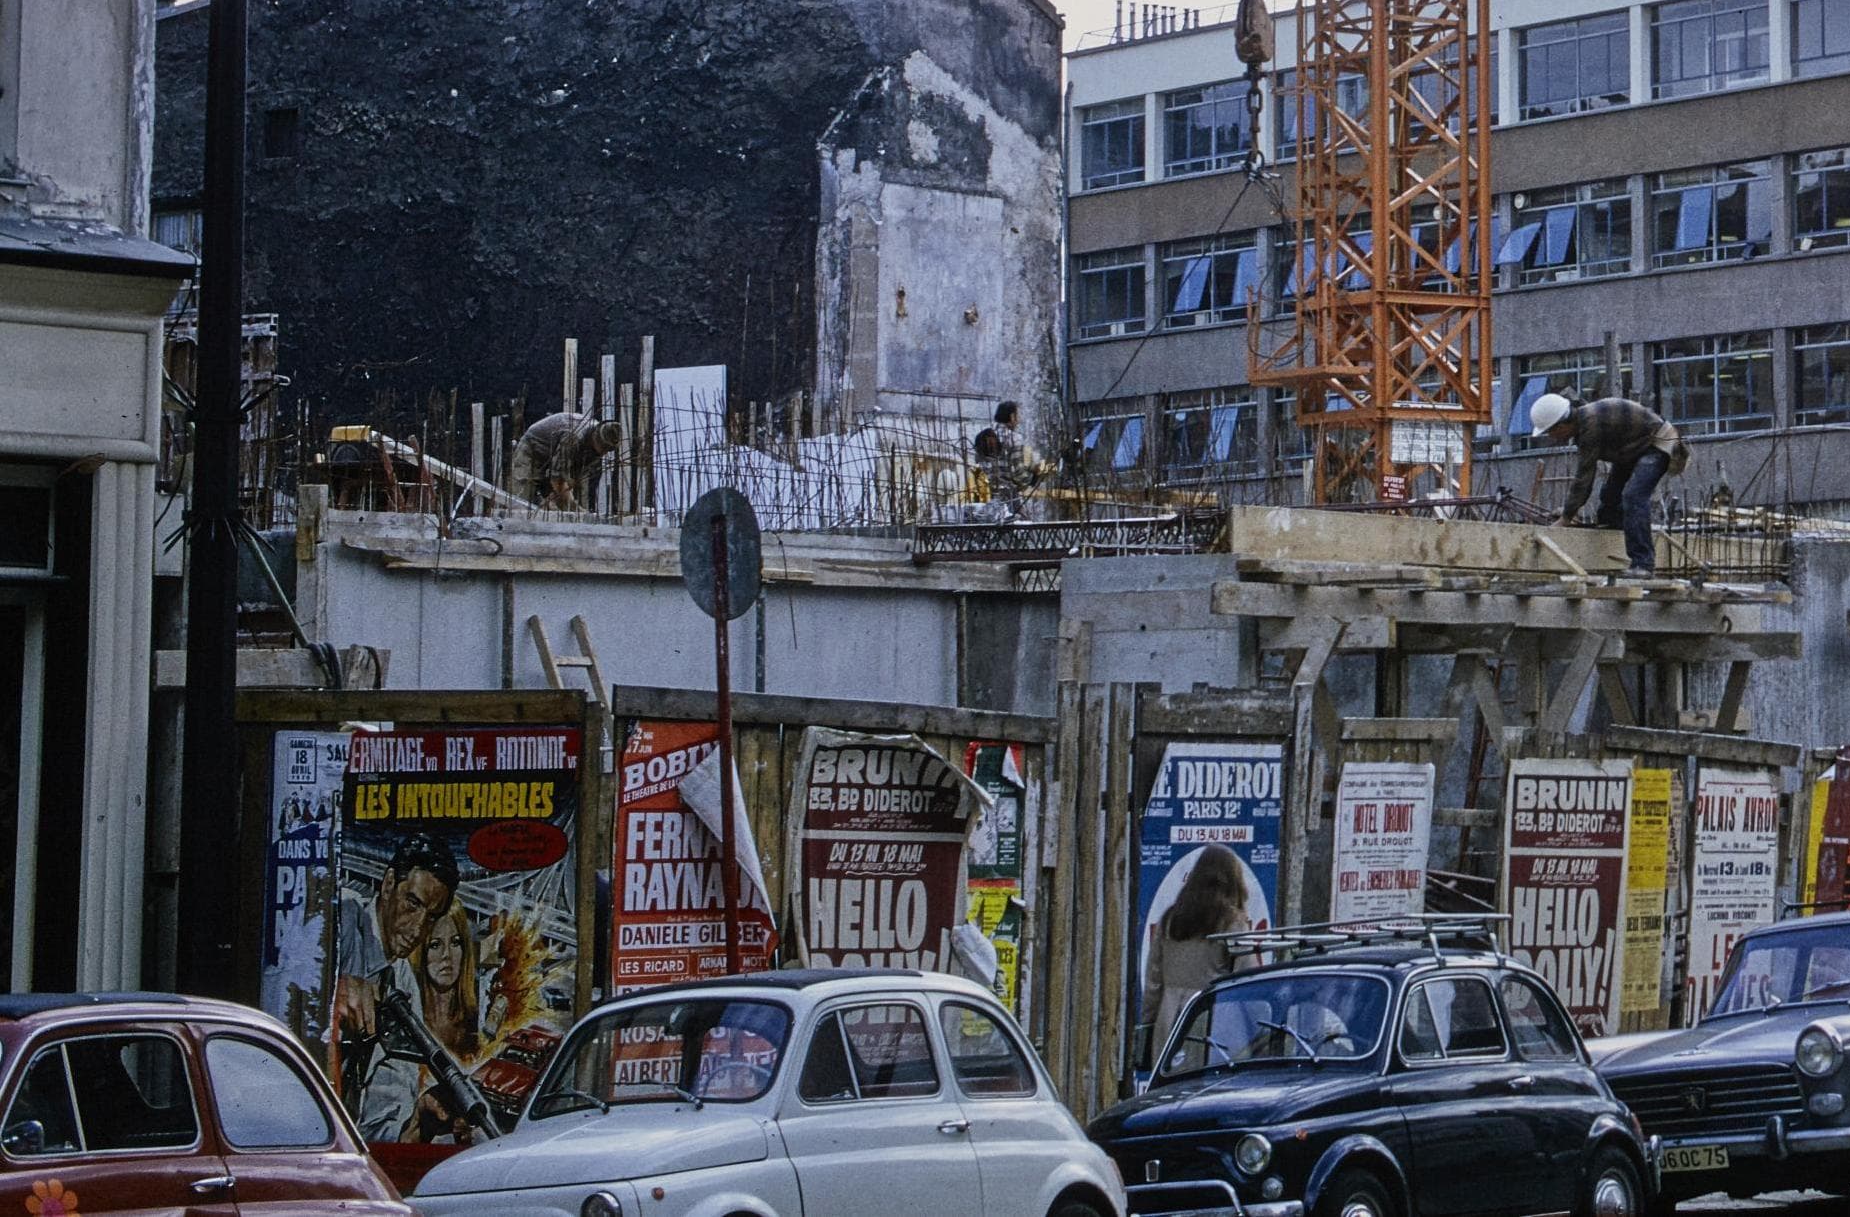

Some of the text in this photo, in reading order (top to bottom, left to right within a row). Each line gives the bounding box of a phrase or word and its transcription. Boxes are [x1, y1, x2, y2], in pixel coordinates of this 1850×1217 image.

[296, 750, 307, 764] 18
[350, 737, 424, 773] ERMITAGE
[446, 737, 475, 772] REX
[496, 735, 567, 771] ROTONDE
[633, 741, 639, 753] 7
[1177, 761, 1281, 799] DIDEROT
[355, 781, 554, 820] LES INTOUCHABLES
[864, 788, 935, 813] DIDEROT
[1517, 778, 1625, 811] BRUNIN
[1183, 801, 1221, 818] PARIS
[1353, 803, 1415, 833] HOTEL DROUOT
[1697, 795, 1737, 832] PALAIS
[1743, 796, 1777, 833] AVRON
[1557, 813, 1605, 833] DIDEROT
[627, 812, 723, 860] FERNA
[1178, 829, 1192, 841] DU
[1209, 829, 1219, 840] AU
[1232, 828, 1247, 840] MAI
[1363, 837, 1378, 846] RUE
[1381, 837, 1413, 846] DROUOT
[278, 840, 311, 859] DANS
[829, 842, 924, 863] DU 13 AU 18 MAI
[1532, 858, 1545, 874] DU
[1581, 859, 1598, 874] MAI
[1720, 861, 1734, 876] 13
[1750, 861, 1764, 876] 18
[809, 877, 928, 950] HELLO
[1512, 886, 1600, 947] HELLO
[622, 925, 690, 946] DANIELE
[620, 960, 685, 974] LES RICARD
[1703, 1147, 1726, 1166] 75
